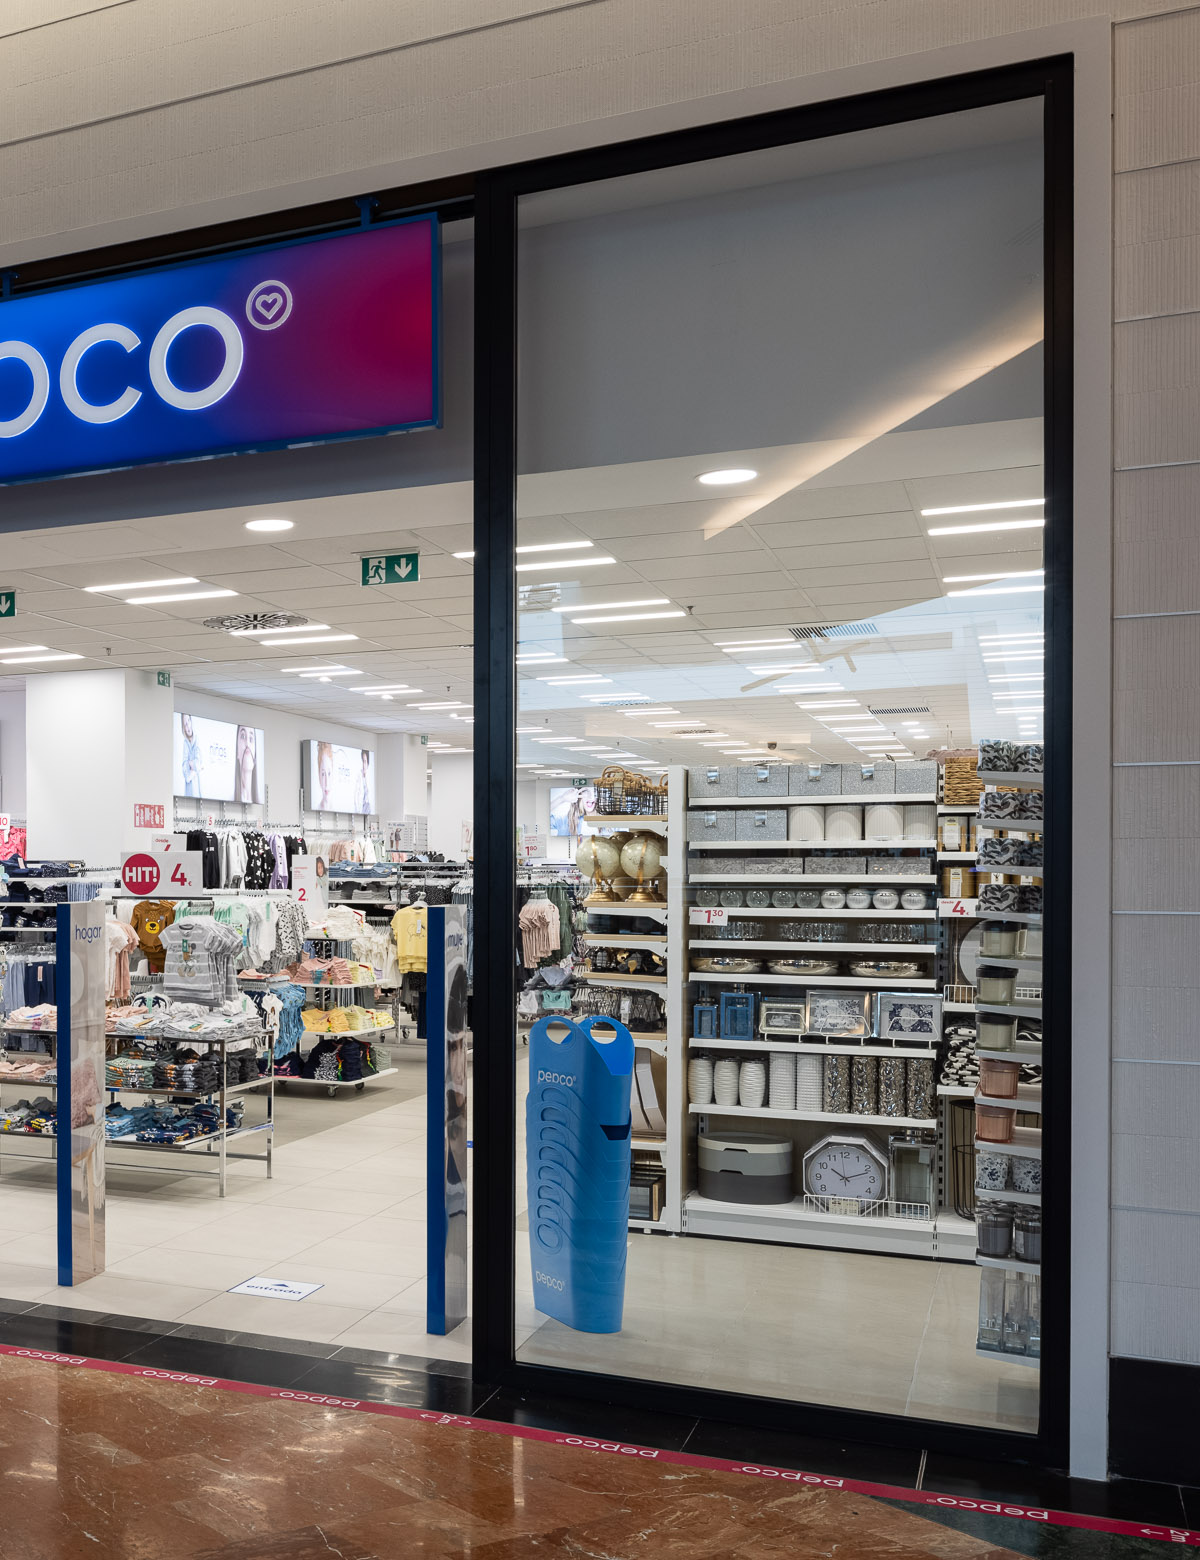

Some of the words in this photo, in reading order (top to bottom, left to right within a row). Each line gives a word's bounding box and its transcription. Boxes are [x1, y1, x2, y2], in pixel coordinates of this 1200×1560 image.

[125, 866, 158, 883] HIT!
[170, 863, 187, 887] 4
[298, 887, 307, 902] 2
[952, 900, 966, 916] 4
[75, 924, 102, 944] hogar
[537, 1070, 573, 1087] pepco
[827, 1154, 837, 1162] 11
[840, 1151, 850, 1159] 12
[819, 1161, 828, 1170] 10
[864, 1164, 871, 1172] 2
[820, 1184, 827, 1192] 8
[869, 1176, 876, 1184] 3
[865, 1187, 872, 1195] 4
[535, 1270, 563, 1291] pepco
[15, 1349, 87, 1365] pepco
[142, 1370, 218, 1386] pepco
[278, 1391, 360, 1408] pepco
[565, 1437, 660, 1458] pepco
[741, 1466, 845, 1488] pepco
[936, 1496, 1049, 1520] pepco
